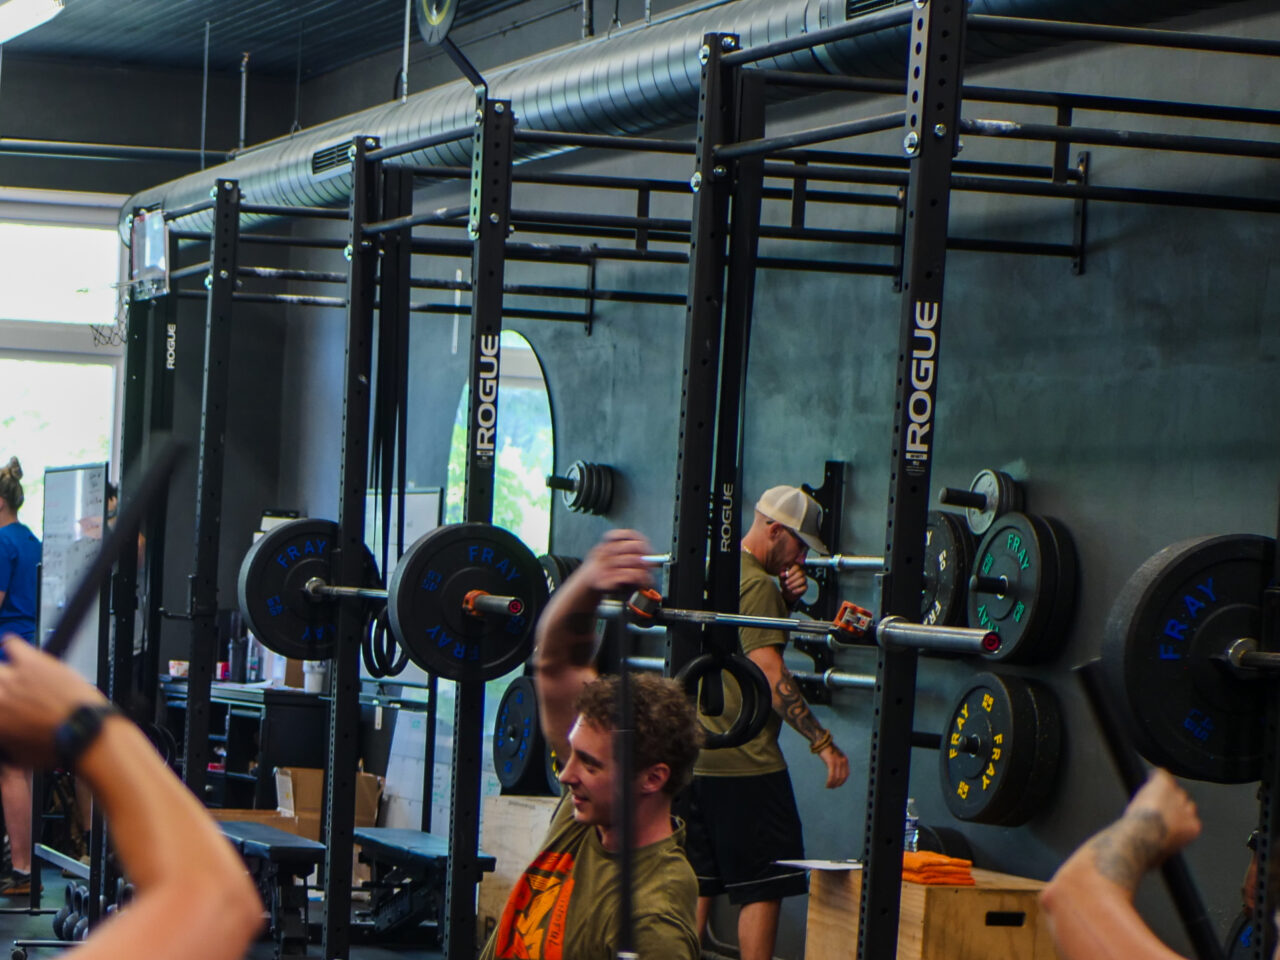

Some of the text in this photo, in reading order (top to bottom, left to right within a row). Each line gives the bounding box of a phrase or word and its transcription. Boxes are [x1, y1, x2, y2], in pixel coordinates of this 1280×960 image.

[166, 323, 176, 370] ROGUE
[477, 334, 499, 450] ROGUE
[905, 301, 939, 452] ROGUE
[720, 483, 734, 552] ROGUE
[277, 540, 327, 569] FRAY
[468, 546, 520, 582] FRAY
[1007, 533, 1030, 571] FRAY
[923, 600, 942, 625] FRA
[1160, 576, 1217, 661] FRAY
[949, 703, 969, 760] FRAY
[982, 733, 1004, 791] FRAY
